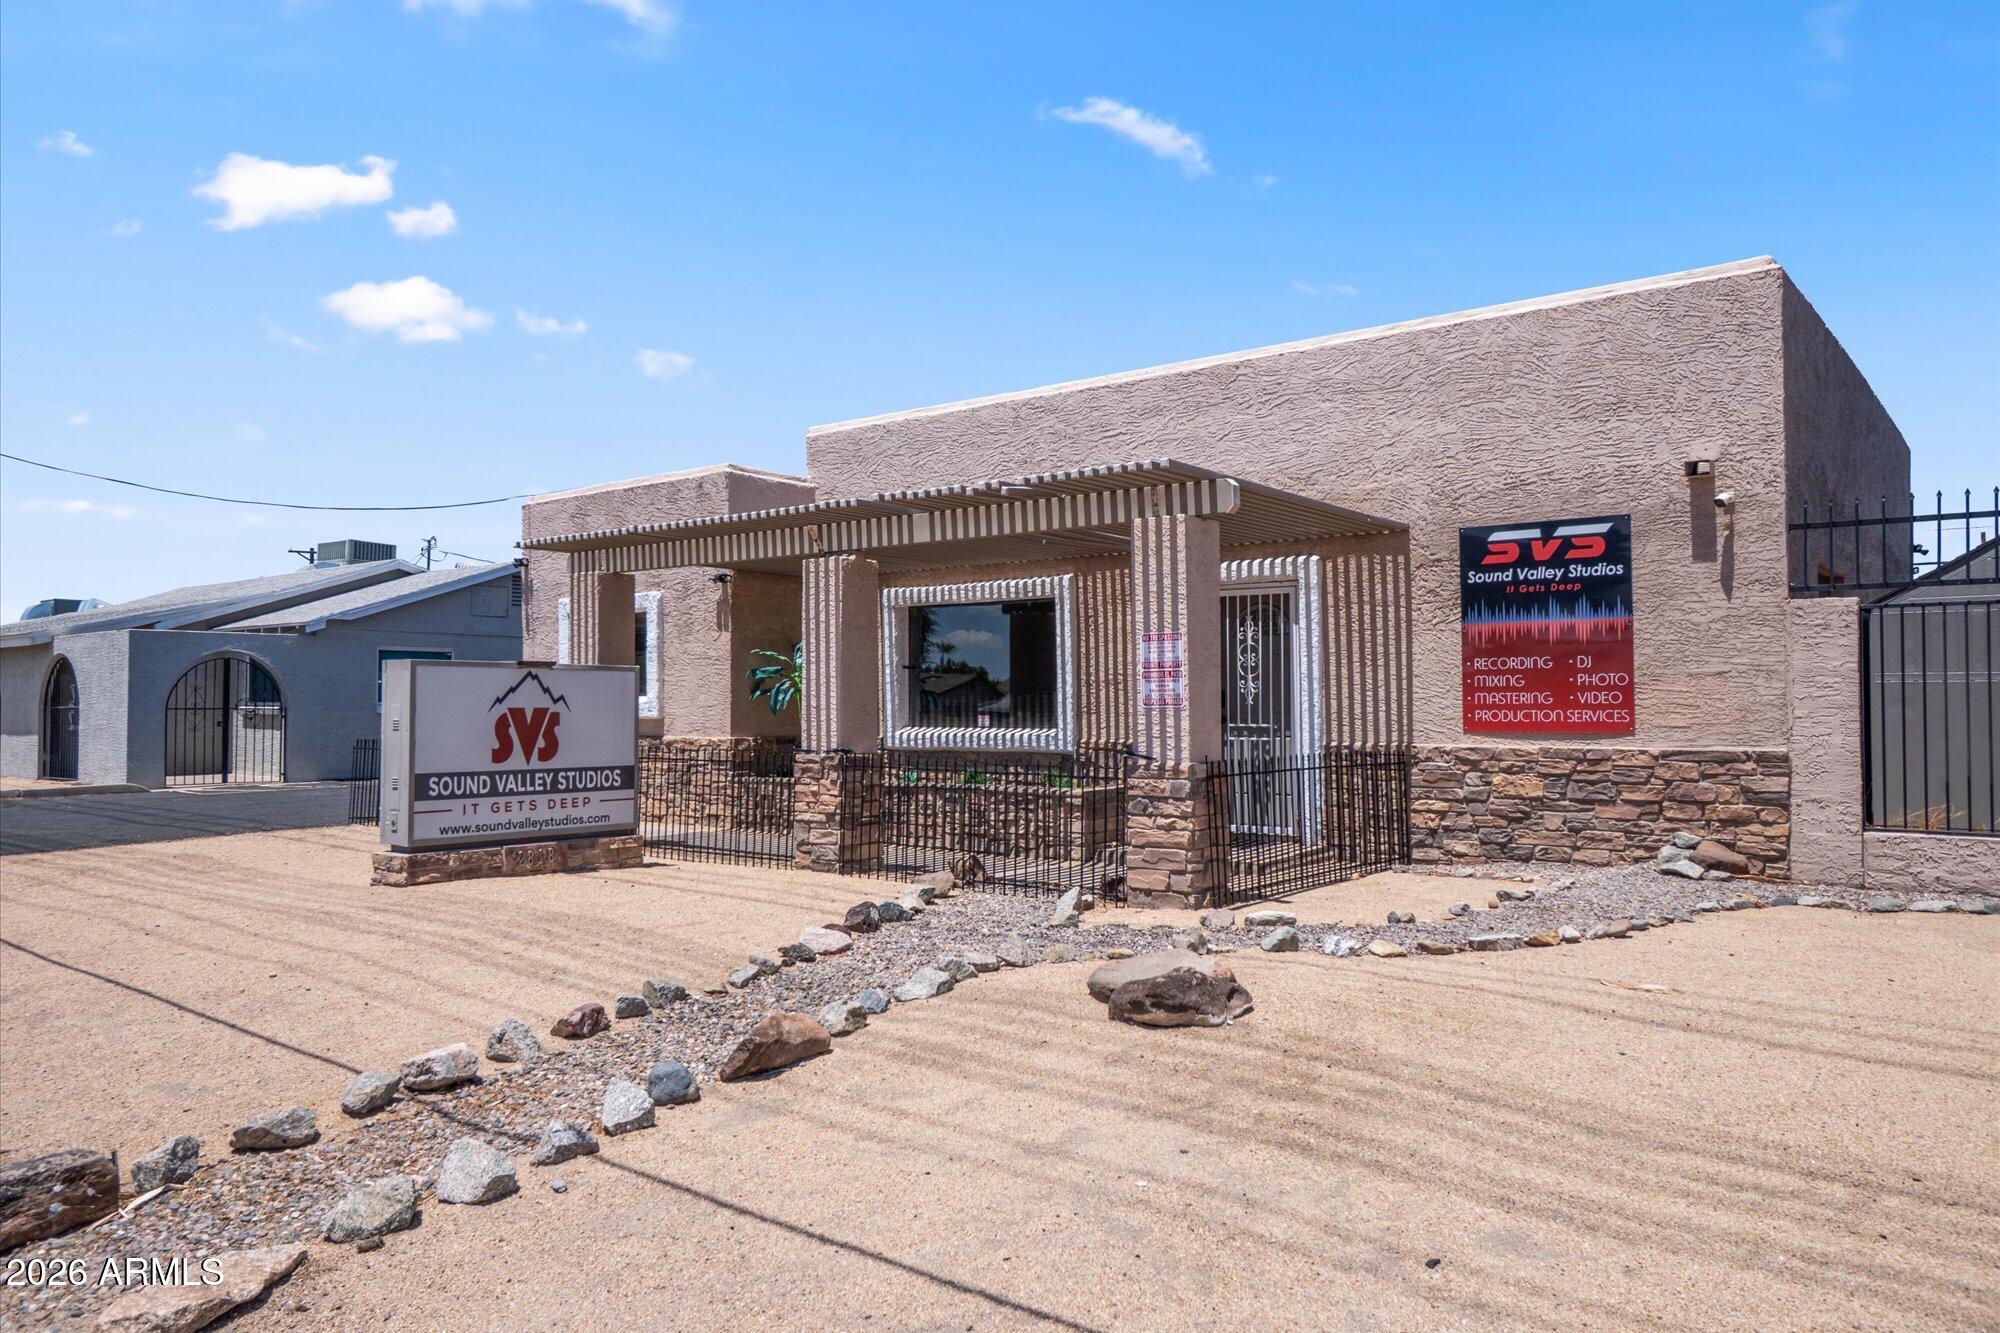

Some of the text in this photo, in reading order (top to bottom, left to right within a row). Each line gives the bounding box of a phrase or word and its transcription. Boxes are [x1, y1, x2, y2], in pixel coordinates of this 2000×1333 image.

[1480, 522, 1614, 565] SVS
[1467, 562, 1624, 583] Sound Valley Studios
[1506, 582, 1582, 593] It Gets Deep
[1474, 656, 1553, 670] RECORDING
[1577, 655, 1592, 668] DJ
[1474, 674, 1525, 687] MIXING
[1577, 673, 1629, 687] PHOTO
[1474, 692, 1553, 704] MASTERING
[1578, 691, 1622, 704] VIDEO
[1475, 709, 1630, 723] PRODUCTION SERVICES
[491, 707, 561, 766] SVS
[428, 769, 622, 797] SOUND VALLEY STUDIOS
[463, 797, 591, 815] IT GETS DEEP
[439, 813, 611, 836] www.soundvalleystudios.com
